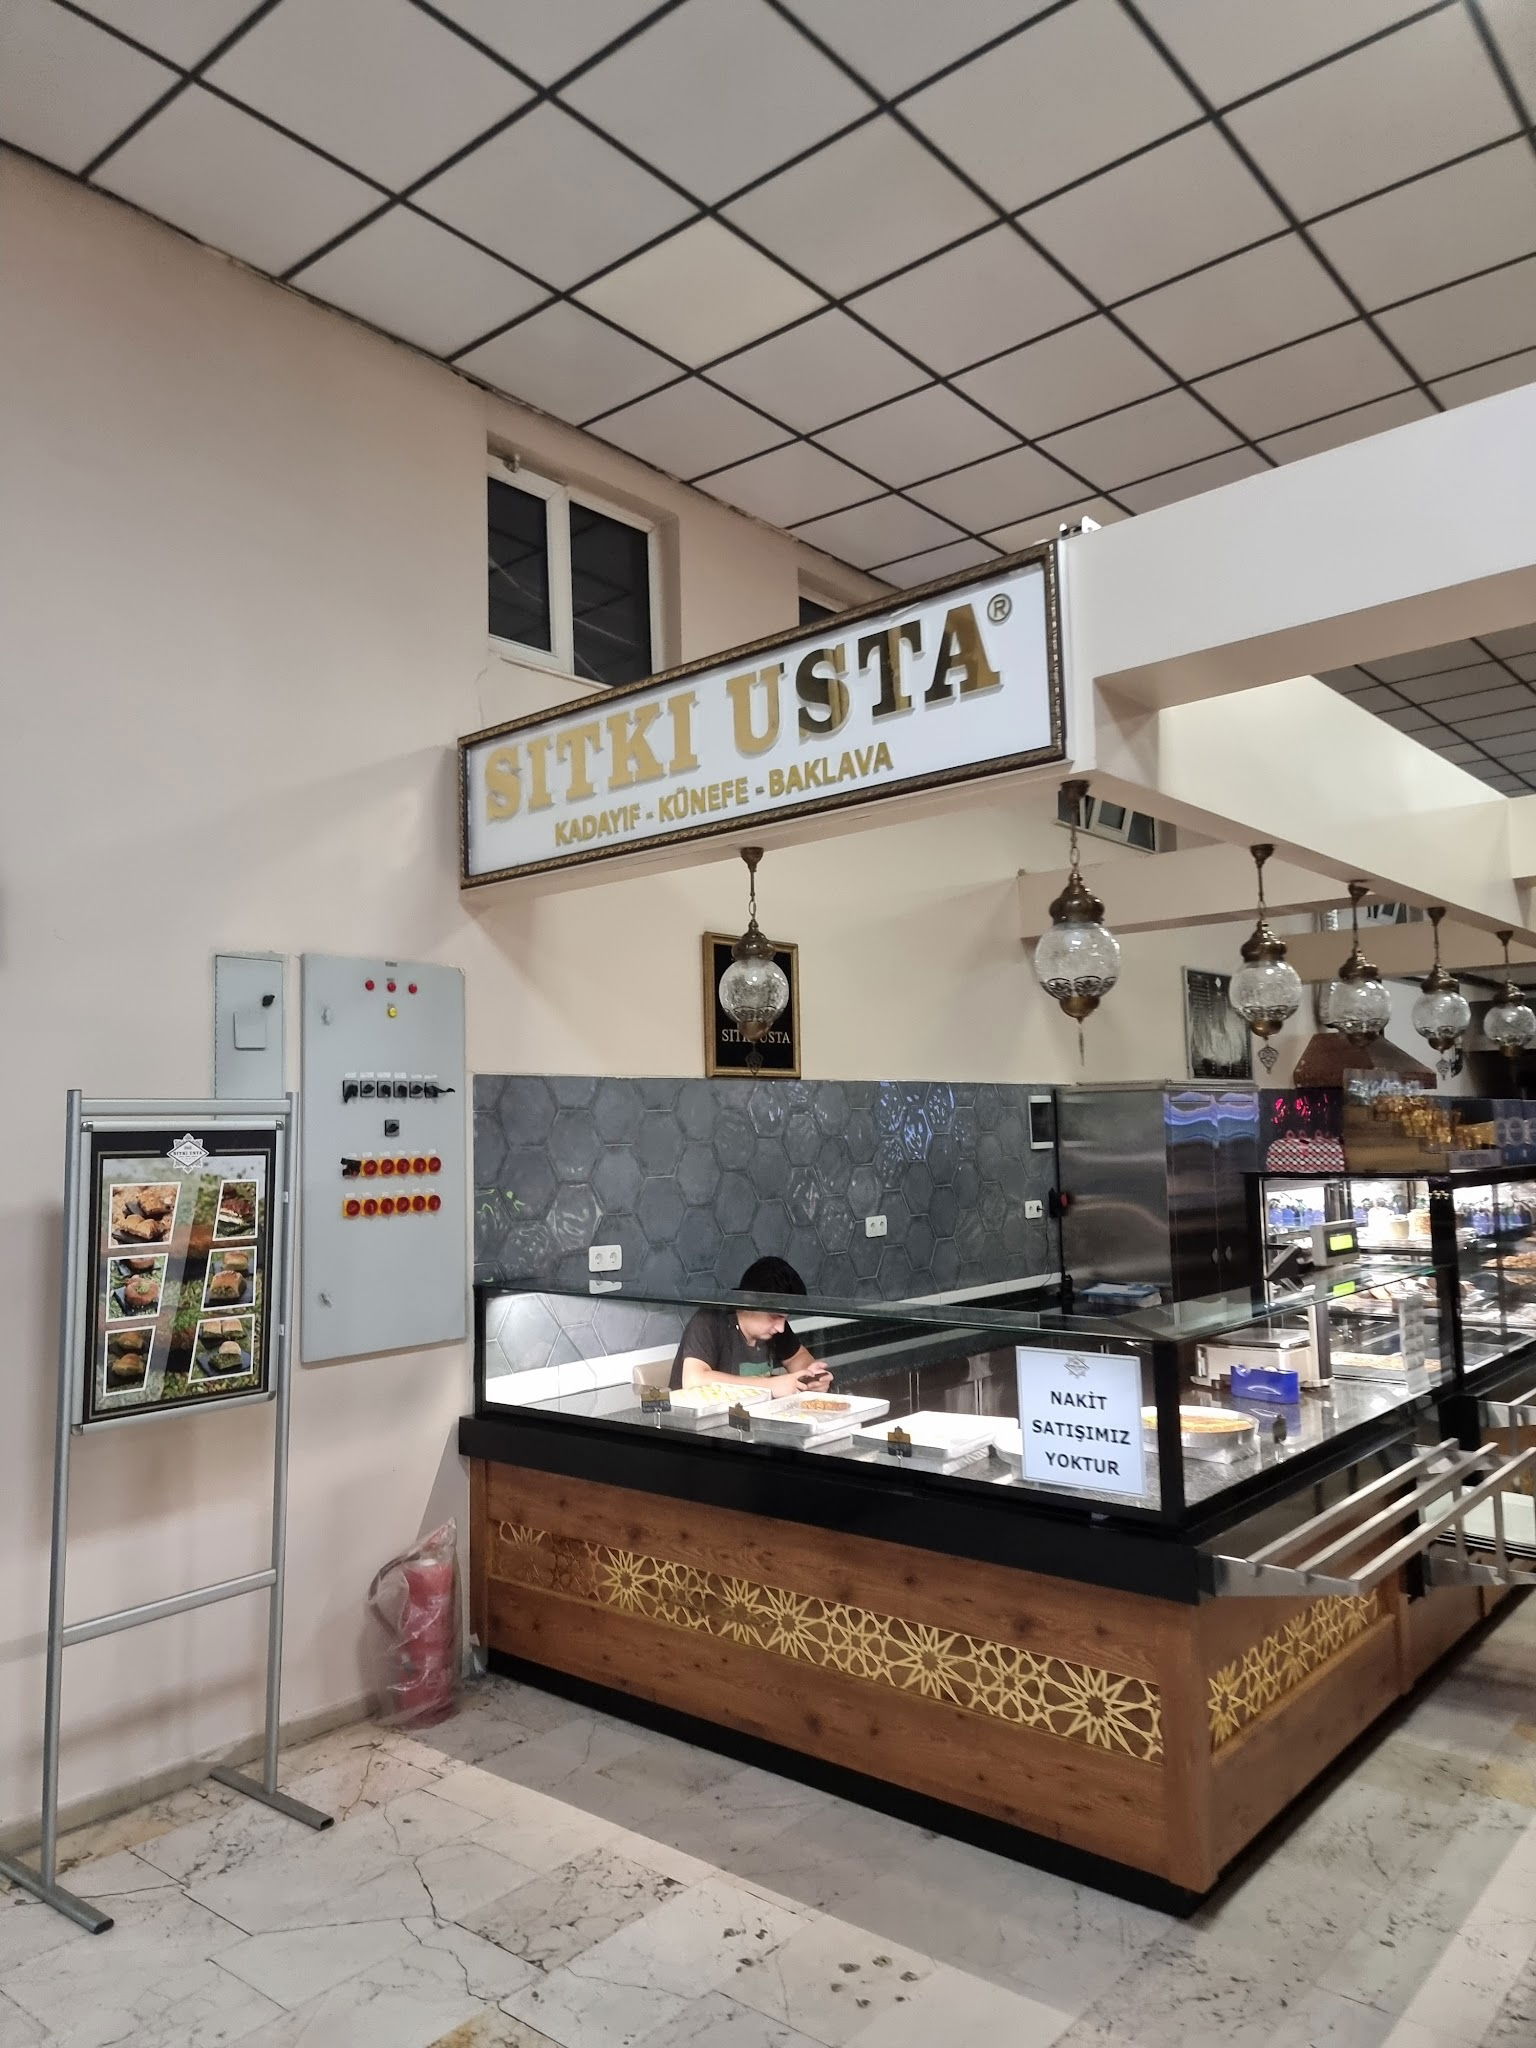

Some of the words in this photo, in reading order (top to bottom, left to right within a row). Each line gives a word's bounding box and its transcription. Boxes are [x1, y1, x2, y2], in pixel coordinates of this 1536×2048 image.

[485, 691, 699, 822] SITKI
[555, 803, 640, 846] KADAYIF
[659, 776, 749, 823] KÜNEFE
[768, 741, 893, 798] BAKLAVA
[721, 1028, 753, 1042] SIT
[1050, 1391, 1108, 1410] NAKİT
[1032, 1419, 1131, 1445] SATIŞIMIZ
[1045, 1451, 1120, 1476] YOKTUR
